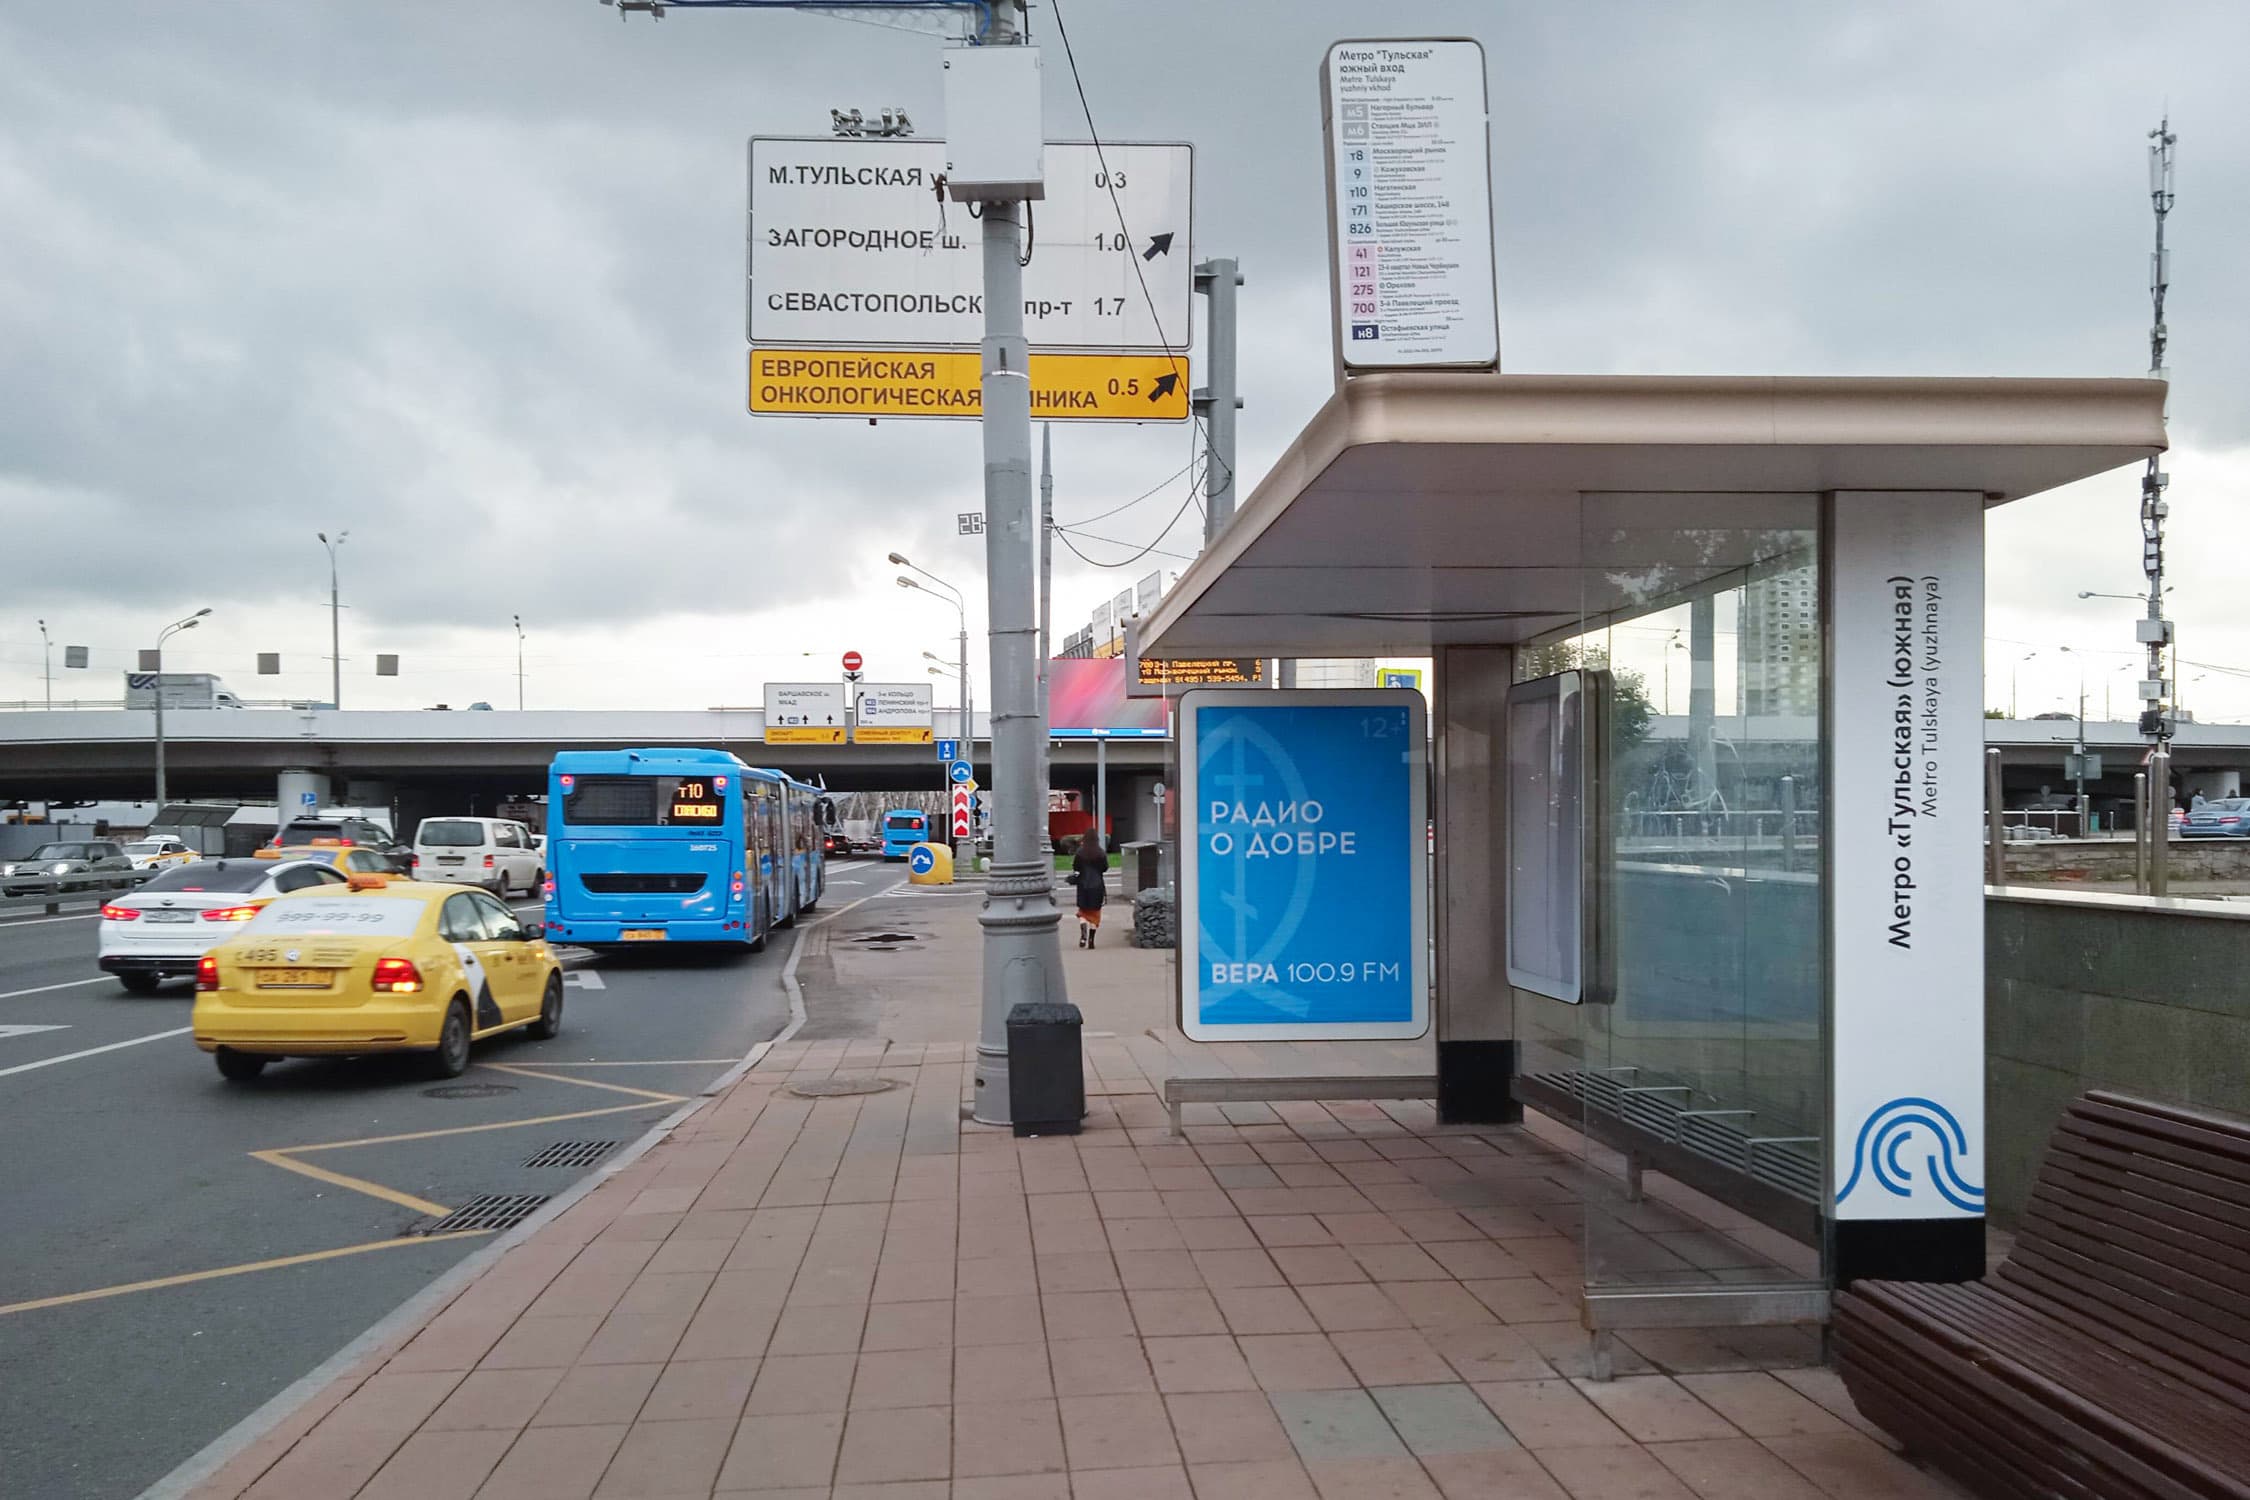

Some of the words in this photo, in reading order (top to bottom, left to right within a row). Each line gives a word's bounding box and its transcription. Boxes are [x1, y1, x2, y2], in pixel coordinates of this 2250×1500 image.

[1339, 50, 1375, 62] Метро
[1340, 63, 1378, 73] южный
[1380, 64, 1406, 73] вход
[769, 166, 922, 186] М.ТУЛЬСКАЯ
[1095, 172, 1127, 189] 0.3
[1354, 168, 1362, 179] 9
[1350, 186, 1368, 197] т10
[1352, 204, 1368, 216] т71
[1349, 223, 1372, 234] 826
[768, 228, 933, 251] ЗАГОРОДНОЕ
[942, 235, 967, 249] ш.
[1094, 233, 1125, 251] 1.0
[1356, 248, 1368, 259] 41
[1354, 266, 1370, 277] 121
[1353, 285, 1374, 296] 275
[768, 293, 983, 313] СЕВАСТОПОЛЬСК
[1025, 299, 1072, 319] пр-т
[1094, 297, 1125, 315] 1.7
[1353, 303, 1375, 314] 700
[762, 357, 935, 379] ЕВРОПЕЙСКАЯ
[761, 386, 982, 406] ОНКОЛОГИЧЕСКАЯ
[1108, 378, 1139, 396] 0.5
[1886, 576, 1914, 688] (южная)
[1920, 575, 1942, 672] (yuzhnaya)
[1921, 676, 1941, 755] Tulskaya
[1888, 693, 1916, 848] «Тульская»
[677, 783, 703, 798] т10
[1921, 759, 1938, 818] Metro
[1210, 801, 1323, 827] РАДИО
[1210, 832, 1233, 855] О
[1246, 832, 1356, 859] ДОБРЕ
[1888, 855, 1916, 949] Метро
[1212, 963, 1279, 984] ВЕРА
[1287, 962, 1355, 984] 100.9
[1364, 963, 1399, 983] FM
